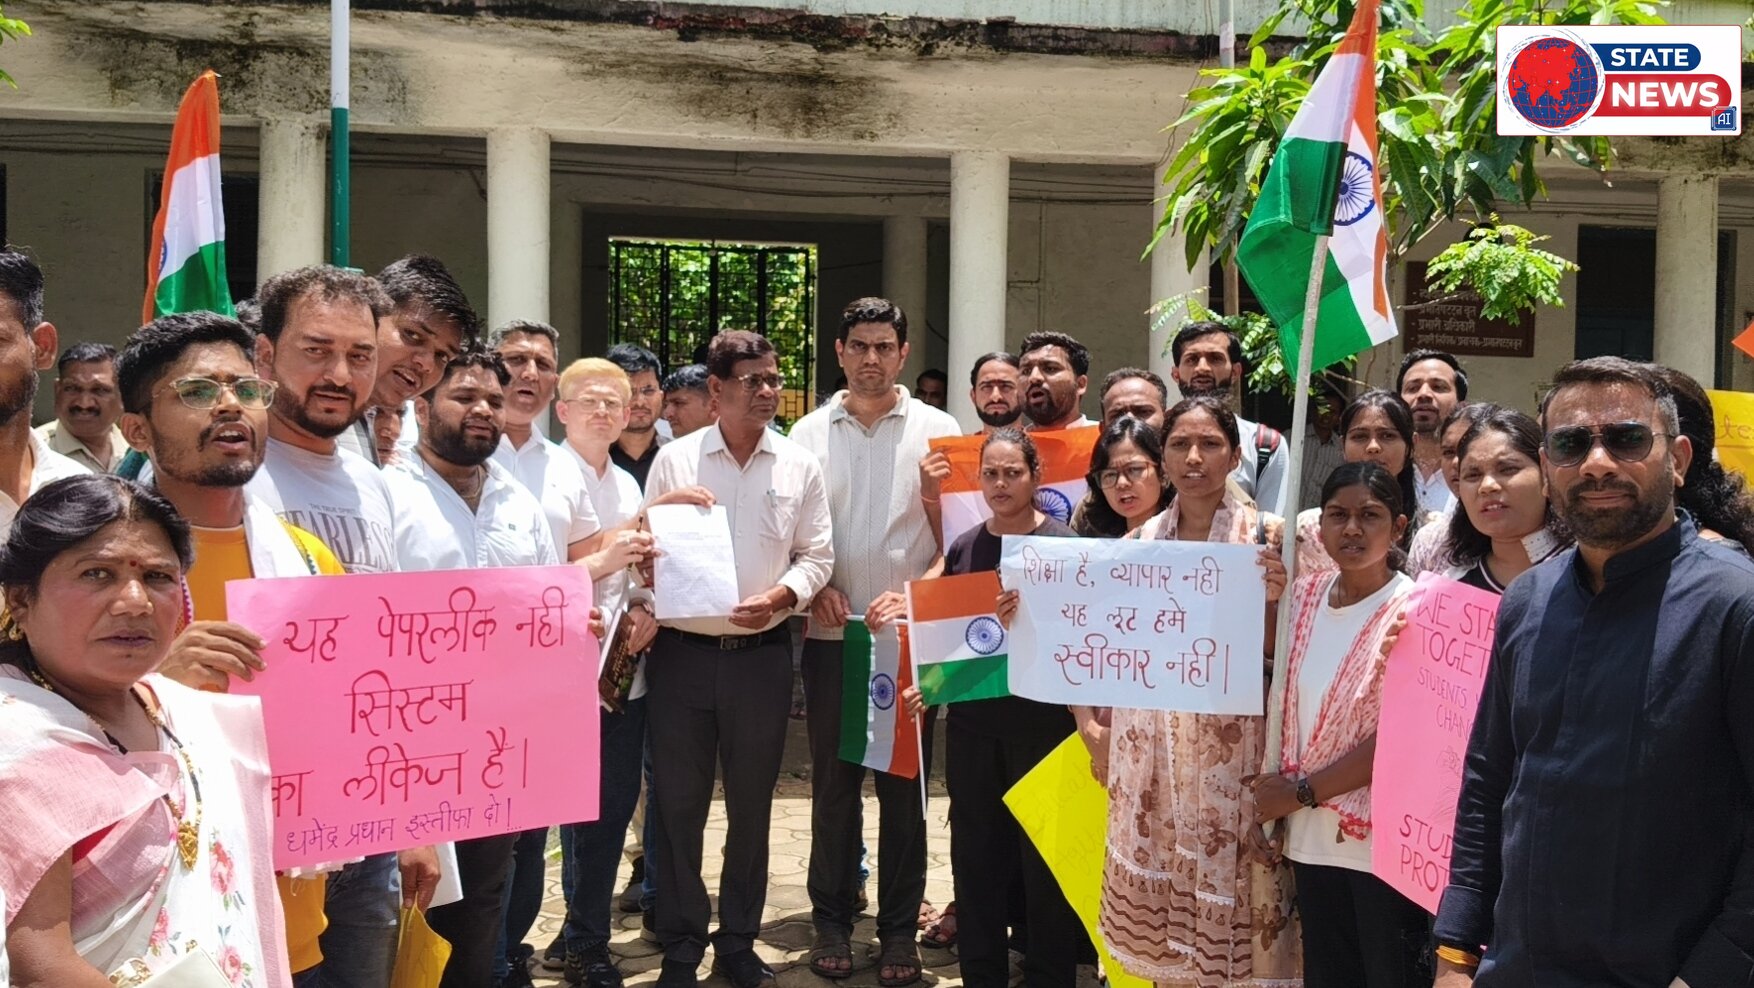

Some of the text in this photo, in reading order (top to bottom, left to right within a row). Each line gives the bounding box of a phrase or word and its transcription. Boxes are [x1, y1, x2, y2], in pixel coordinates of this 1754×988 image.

[1022, 545, 1224, 596] शिक्षा है, व्यापार नही
[283, 586, 570, 664] यह पेपरलीक नही
[1061, 603, 1088, 627] यह
[1106, 606, 1139, 635] लूट
[1416, 588, 1452, 629] WE
[1054, 633, 1156, 690] स्वीकार
[344, 669, 474, 736] सिस्टम
[343, 742, 469, 806] लीकेज
[345, 818, 397, 848] प्रधान
[405, 801, 474, 839] इस्तीफा
